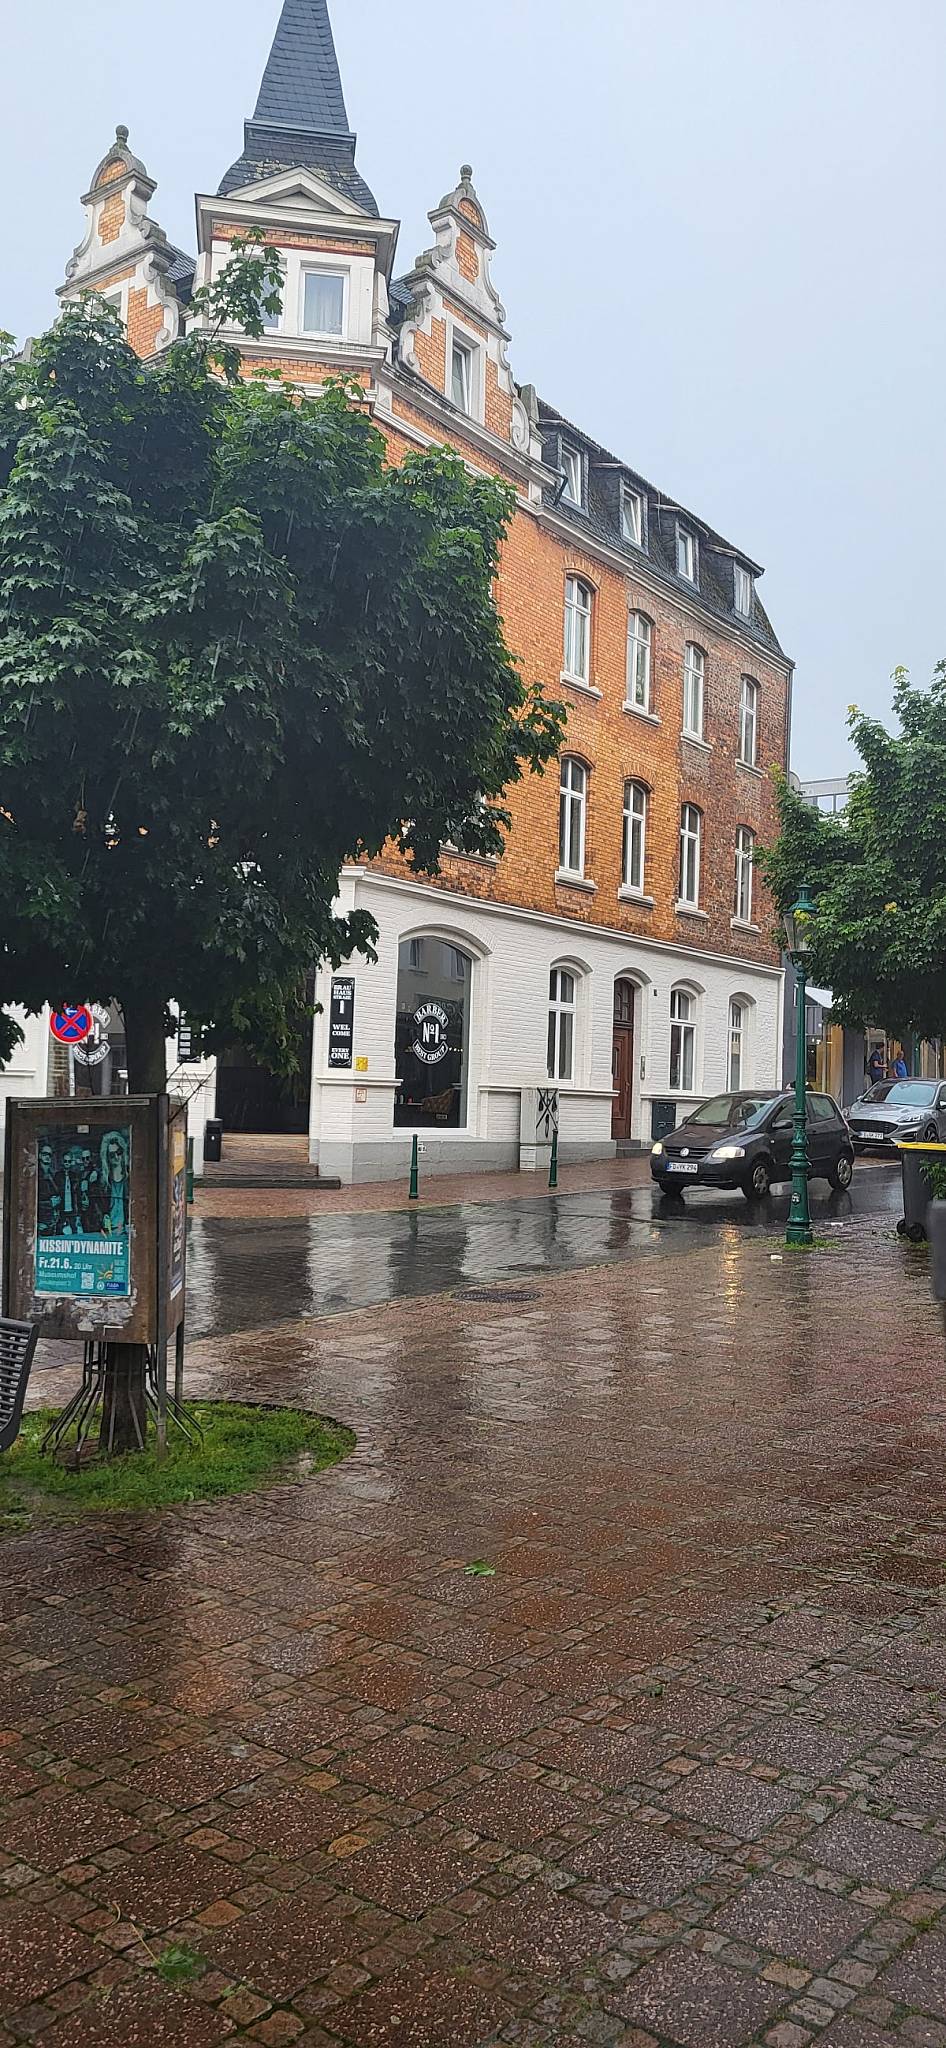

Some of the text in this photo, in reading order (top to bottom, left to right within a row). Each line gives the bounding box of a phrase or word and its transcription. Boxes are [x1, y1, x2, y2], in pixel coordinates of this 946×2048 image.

[415, 1004, 446, 1024] BARBER
[415, 1043, 445, 1061] BEST GROUP
[39, 1240, 123, 1255] KISSIN'DYNAMITE
[38, 1257, 72, 1269] Fr.21.6.
